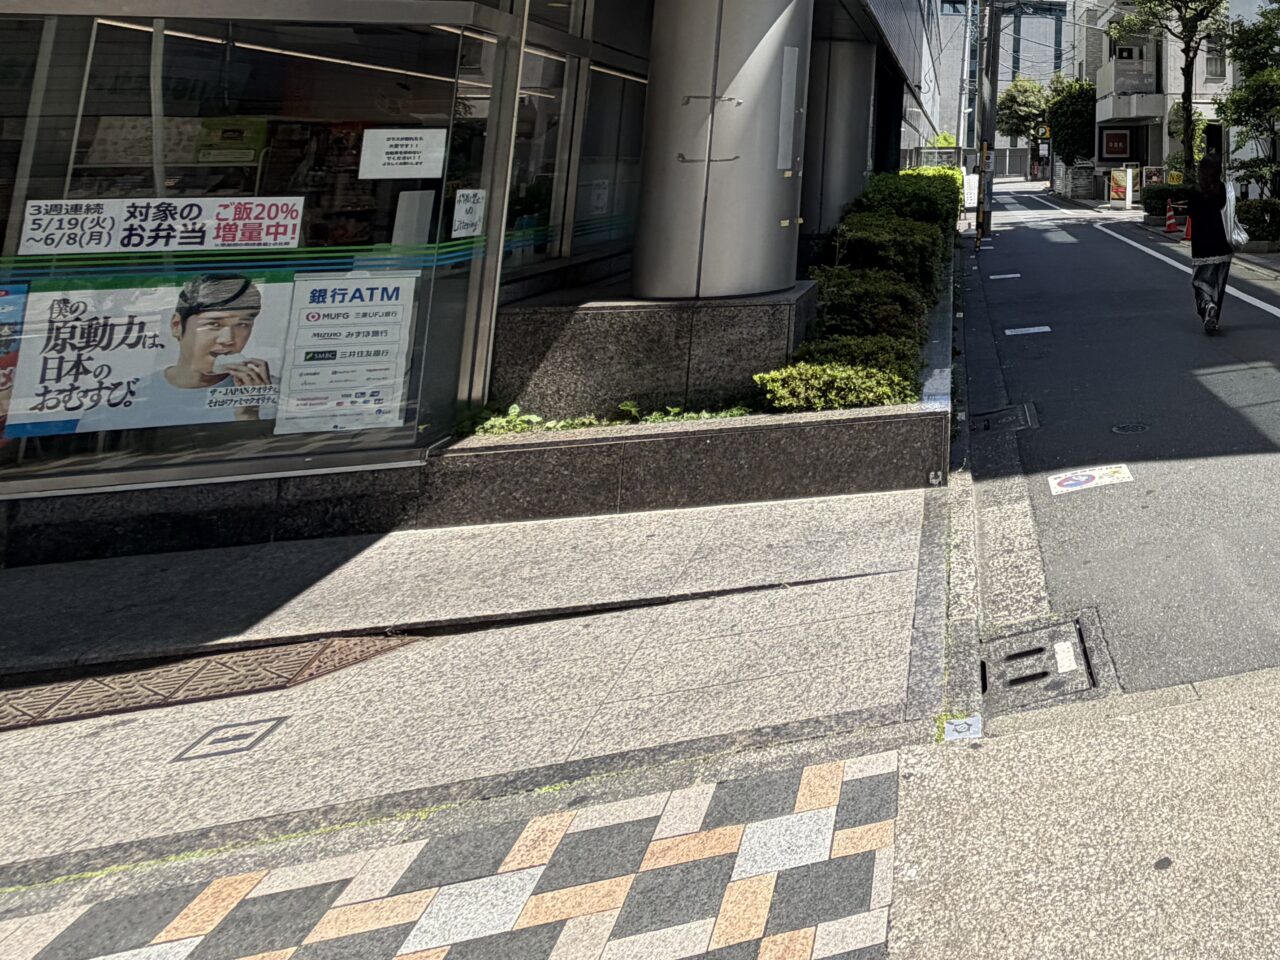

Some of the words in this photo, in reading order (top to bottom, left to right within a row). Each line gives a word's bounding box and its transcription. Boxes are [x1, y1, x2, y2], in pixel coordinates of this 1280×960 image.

[29, 204, 104, 216] 3週連続
[123, 202, 202, 222] 対象の
[214, 202, 299, 221] ご飯20%
[30, 215, 116, 232] 5/19(火)
[212, 222, 298, 242] 増量中!
[120, 222, 207, 248] お弁当
[309, 286, 401, 304] 銀行ATM
[50, 298, 87, 319] 僕の
[322, 311, 350, 320] MUFG
[39, 352, 111, 385] 日本の
